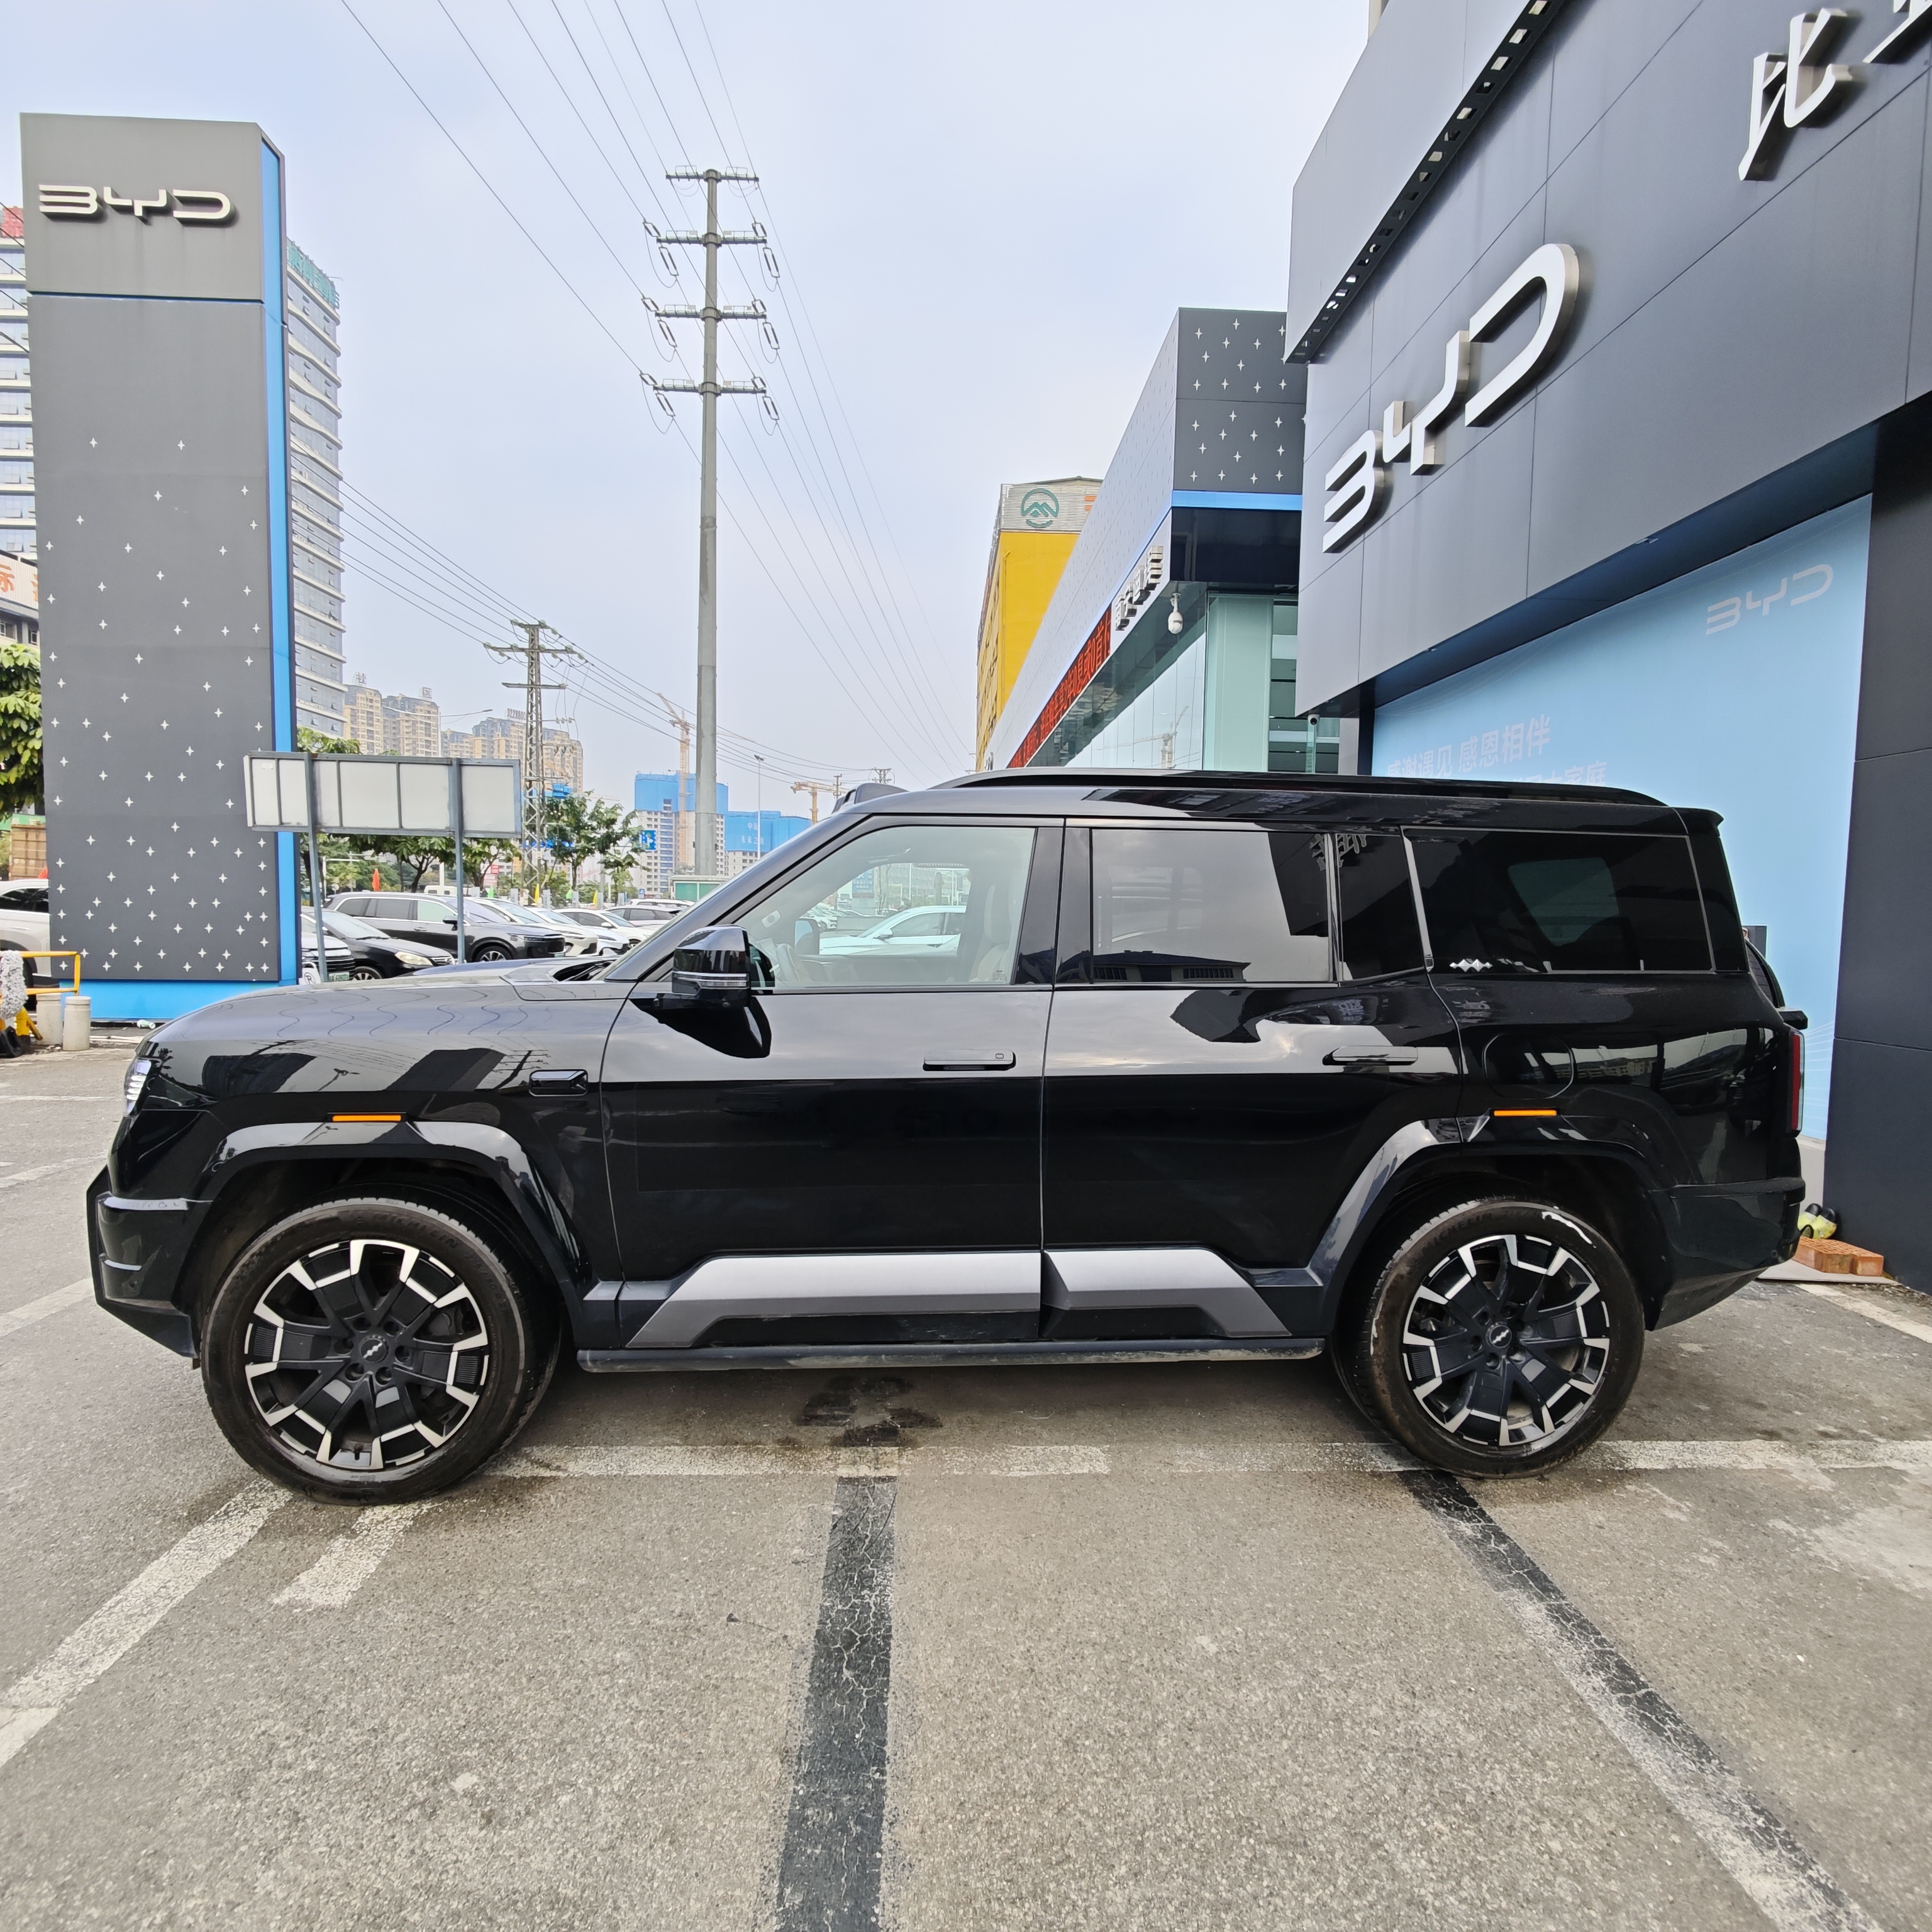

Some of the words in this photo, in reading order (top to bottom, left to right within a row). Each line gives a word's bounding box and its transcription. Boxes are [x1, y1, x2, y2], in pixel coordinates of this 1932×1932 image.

[38, 184, 234, 223] BYD
[1322, 243, 1579, 553] BYD
[1706, 564, 1834, 636] BYD
[1458, 714, 1550, 773] 感恩相伴
